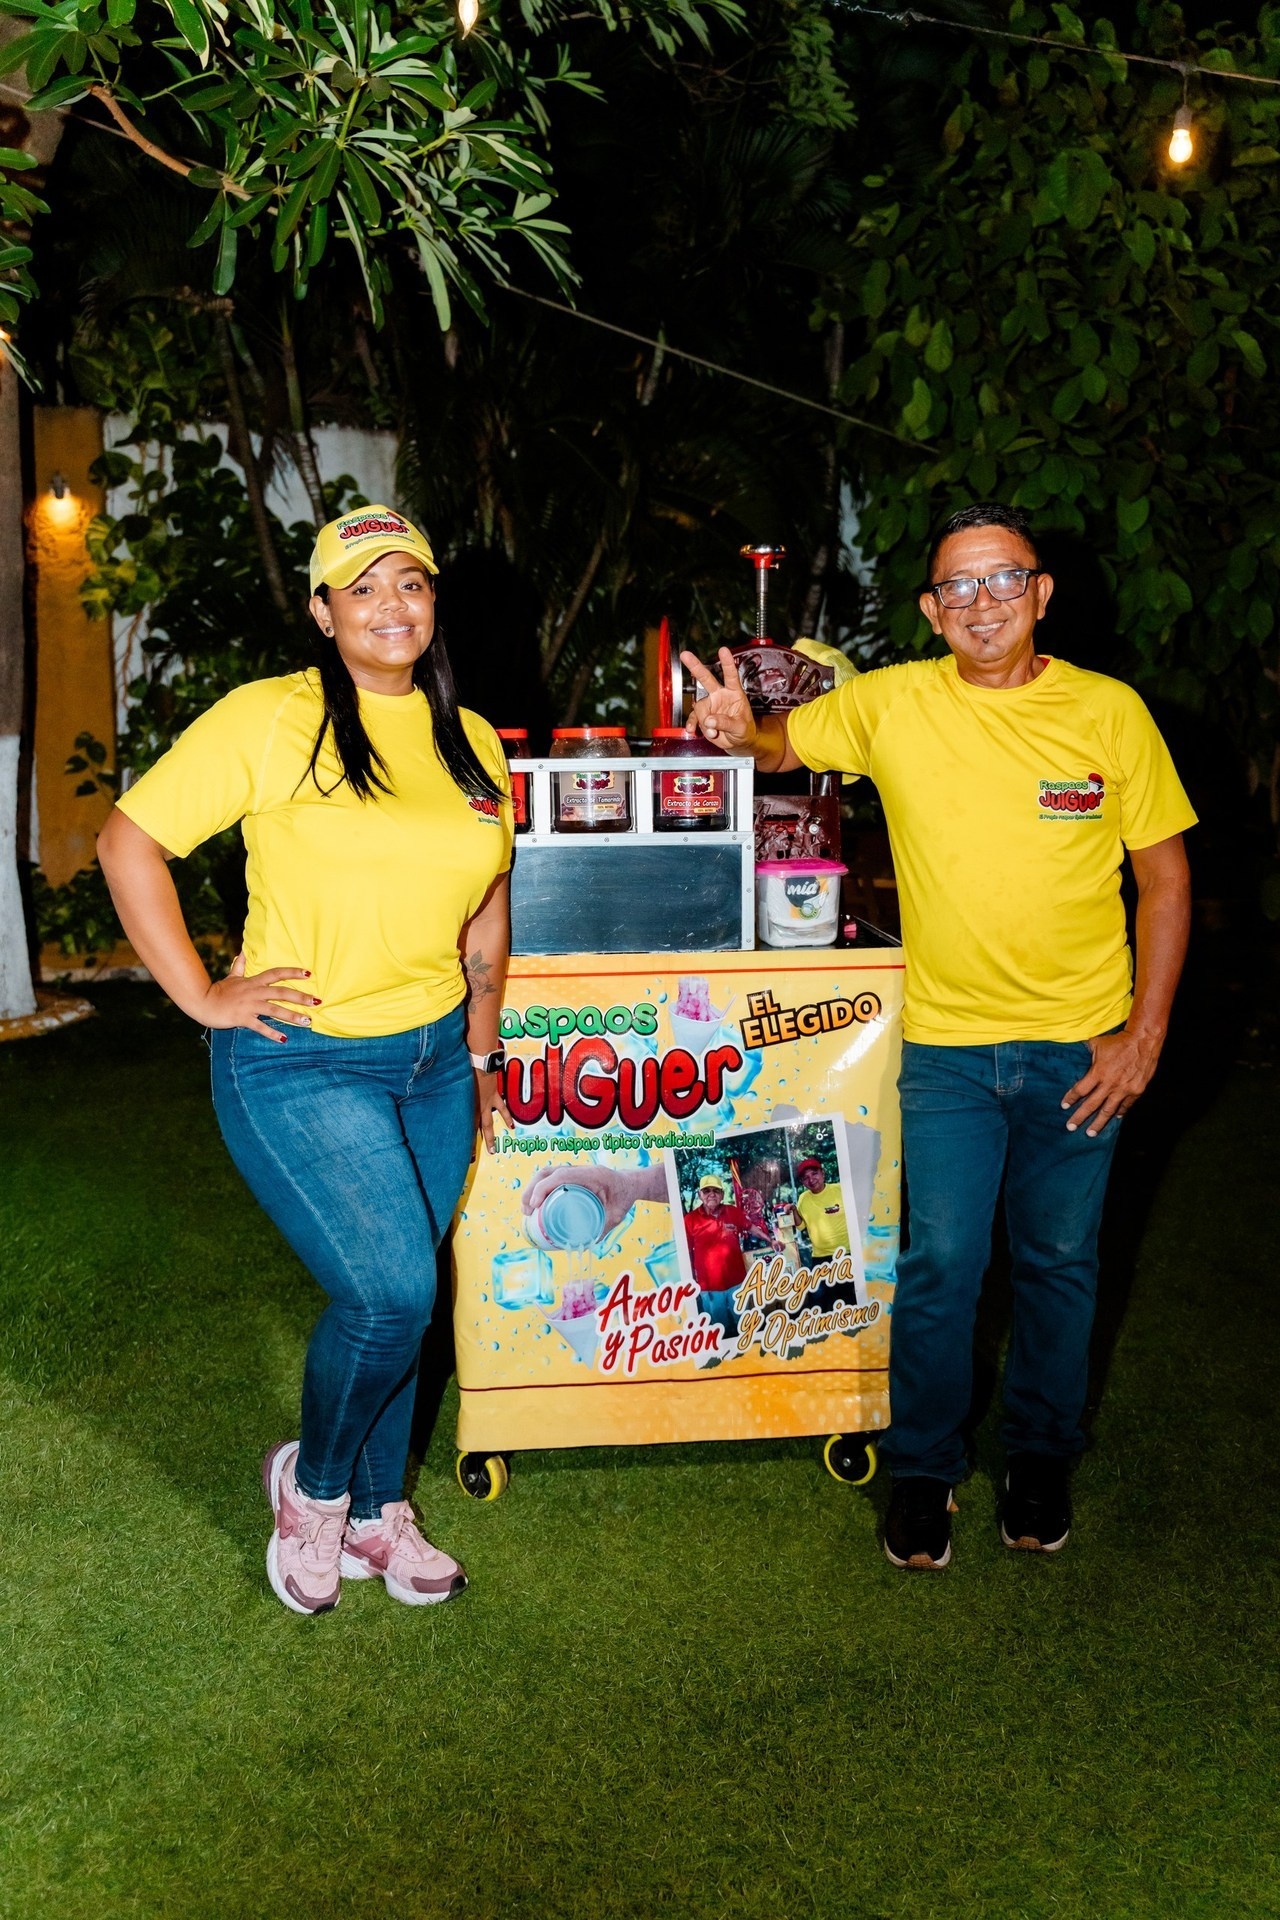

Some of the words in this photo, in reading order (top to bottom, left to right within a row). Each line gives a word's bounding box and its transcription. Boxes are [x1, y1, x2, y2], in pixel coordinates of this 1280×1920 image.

[667, 799, 692, 807] Extracto
[693, 799, 701, 807] de
[1039, 780, 1089, 791] Raspaos
[499, 1003, 658, 1046] aspaos
[739, 992, 882, 1051] ELEGIDO
[747, 990, 781, 1017] EL
[497, 1036, 743, 1130] ulGuer
[502, 1134, 548, 1156] Propio
[550, 1134, 600, 1154] raspao
[642, 1129, 715, 1149] tradicional
[599, 1273, 696, 1333] Amor
[736, 1249, 854, 1312] Alegría
[602, 1329, 625, 1371] y
[627, 1317, 721, 1373] Pasión
[736, 1307, 761, 1351] y
[764, 1301, 880, 1357] Optimismo
